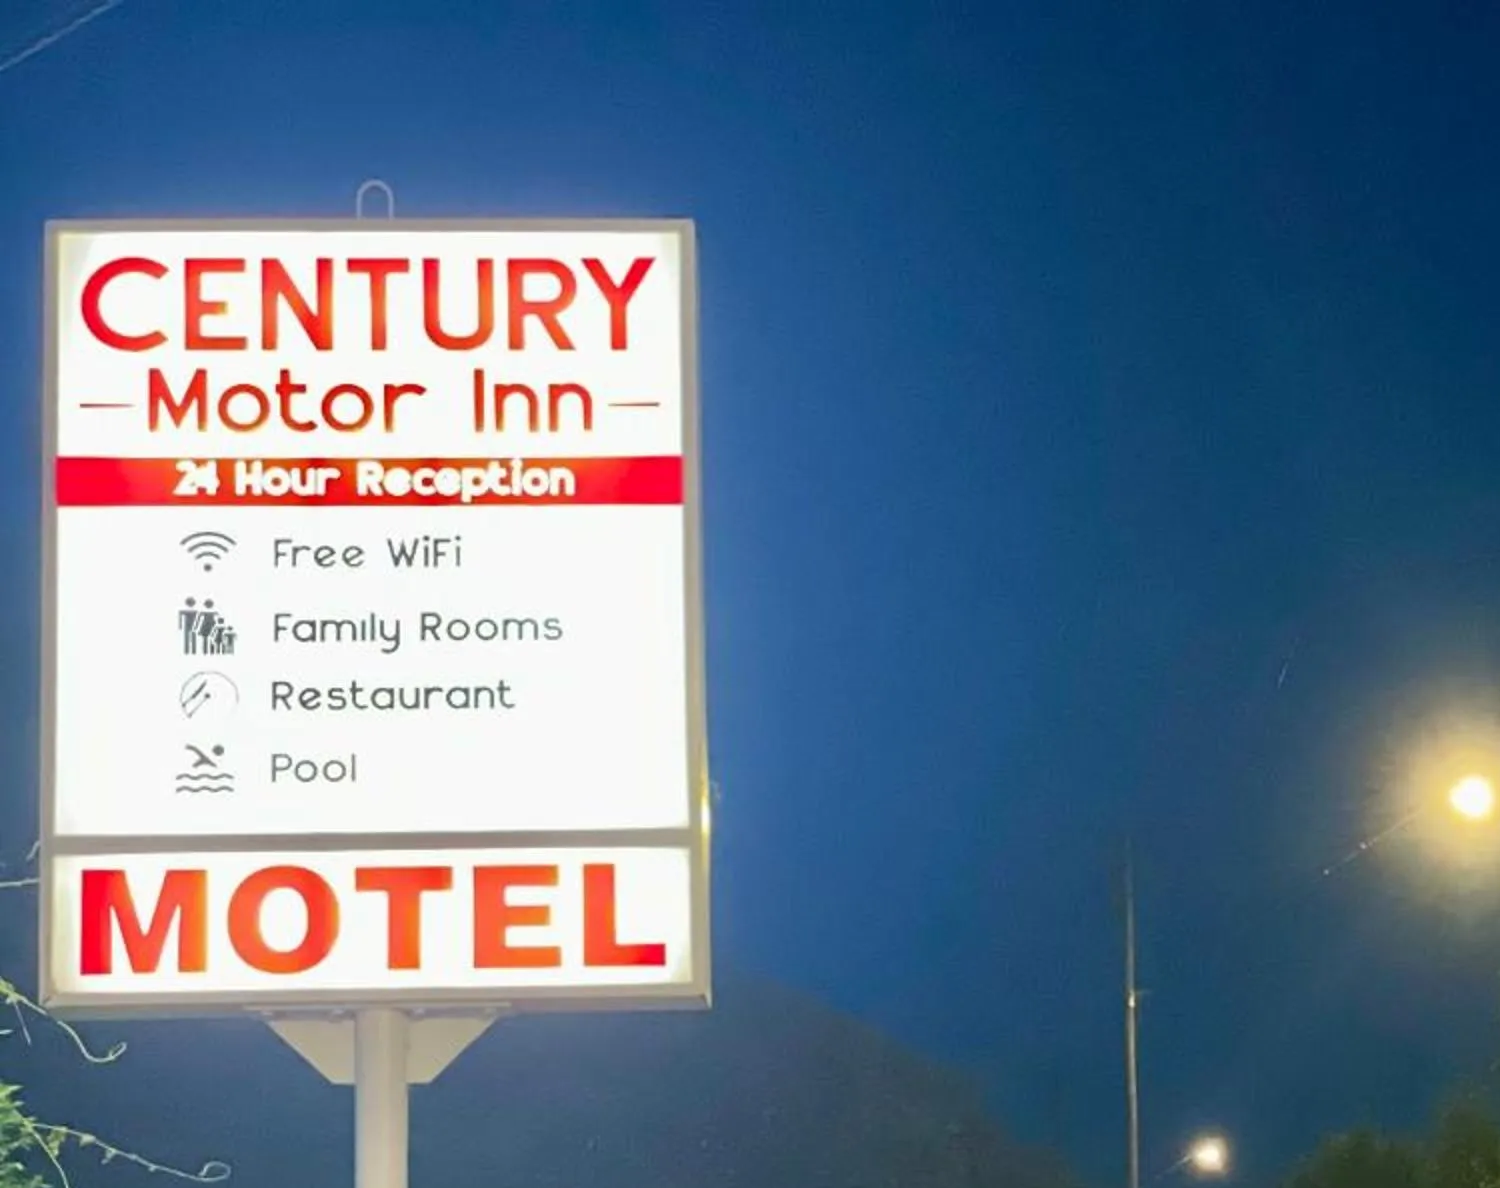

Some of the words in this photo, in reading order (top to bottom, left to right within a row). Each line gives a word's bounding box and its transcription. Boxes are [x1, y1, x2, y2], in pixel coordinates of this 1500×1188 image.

[81, 257, 654, 351] CENTURY
[148, 368, 426, 433] Motor
[474, 368, 592, 433] Inn
[174, 461, 219, 495] 24
[235, 461, 340, 495] Hour
[356, 458, 576, 503] Reception
[273, 538, 365, 568] Free
[387, 535, 463, 568] WiFi
[273, 613, 402, 654] Family
[421, 612, 564, 641] Rooms
[271, 680, 516, 710] Restaurant
[271, 754, 357, 783] Pool
[80, 864, 666, 974] MOTEL
